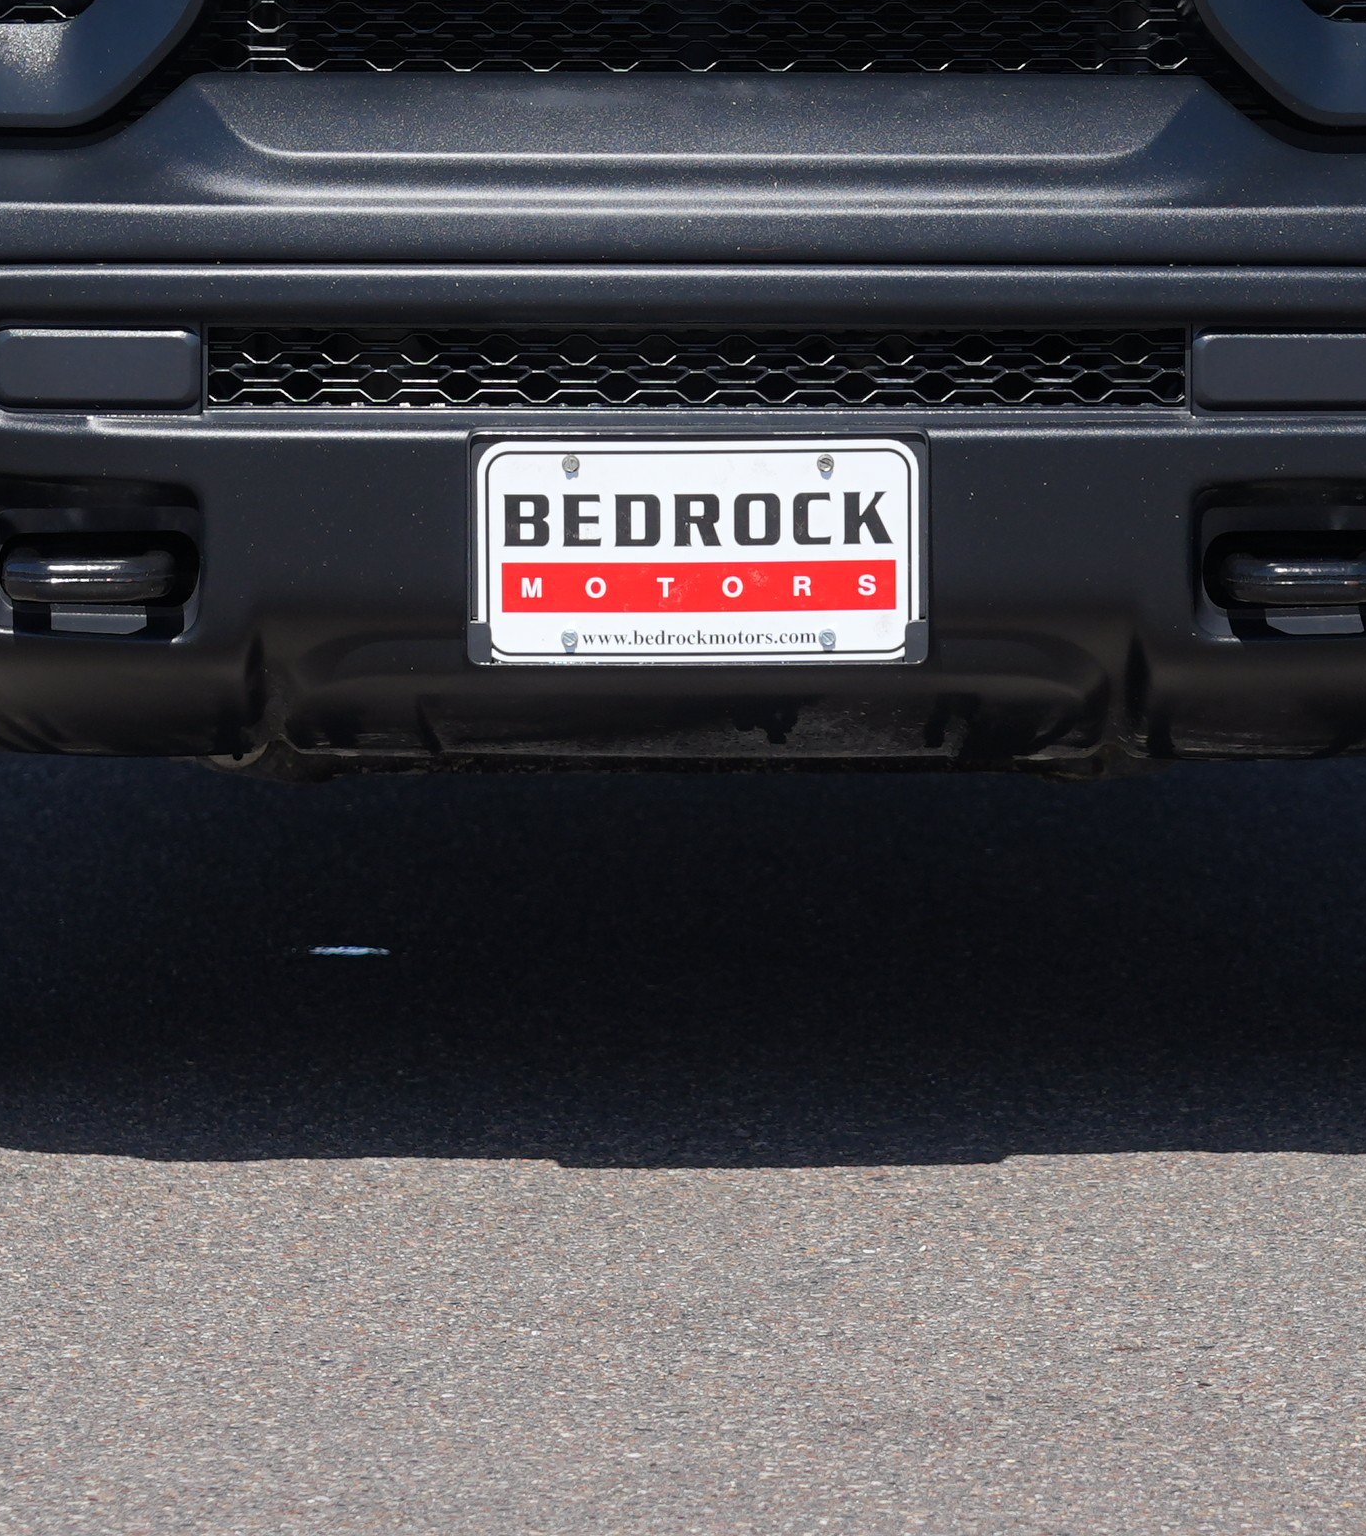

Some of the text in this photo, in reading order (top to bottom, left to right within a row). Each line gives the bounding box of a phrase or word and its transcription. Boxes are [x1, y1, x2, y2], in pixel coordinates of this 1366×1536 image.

[503, 491, 893, 547] BEDROCK
[520, 573, 877, 599] MOTORS
[582, 630, 817, 645] www.bedrockmotors.com
